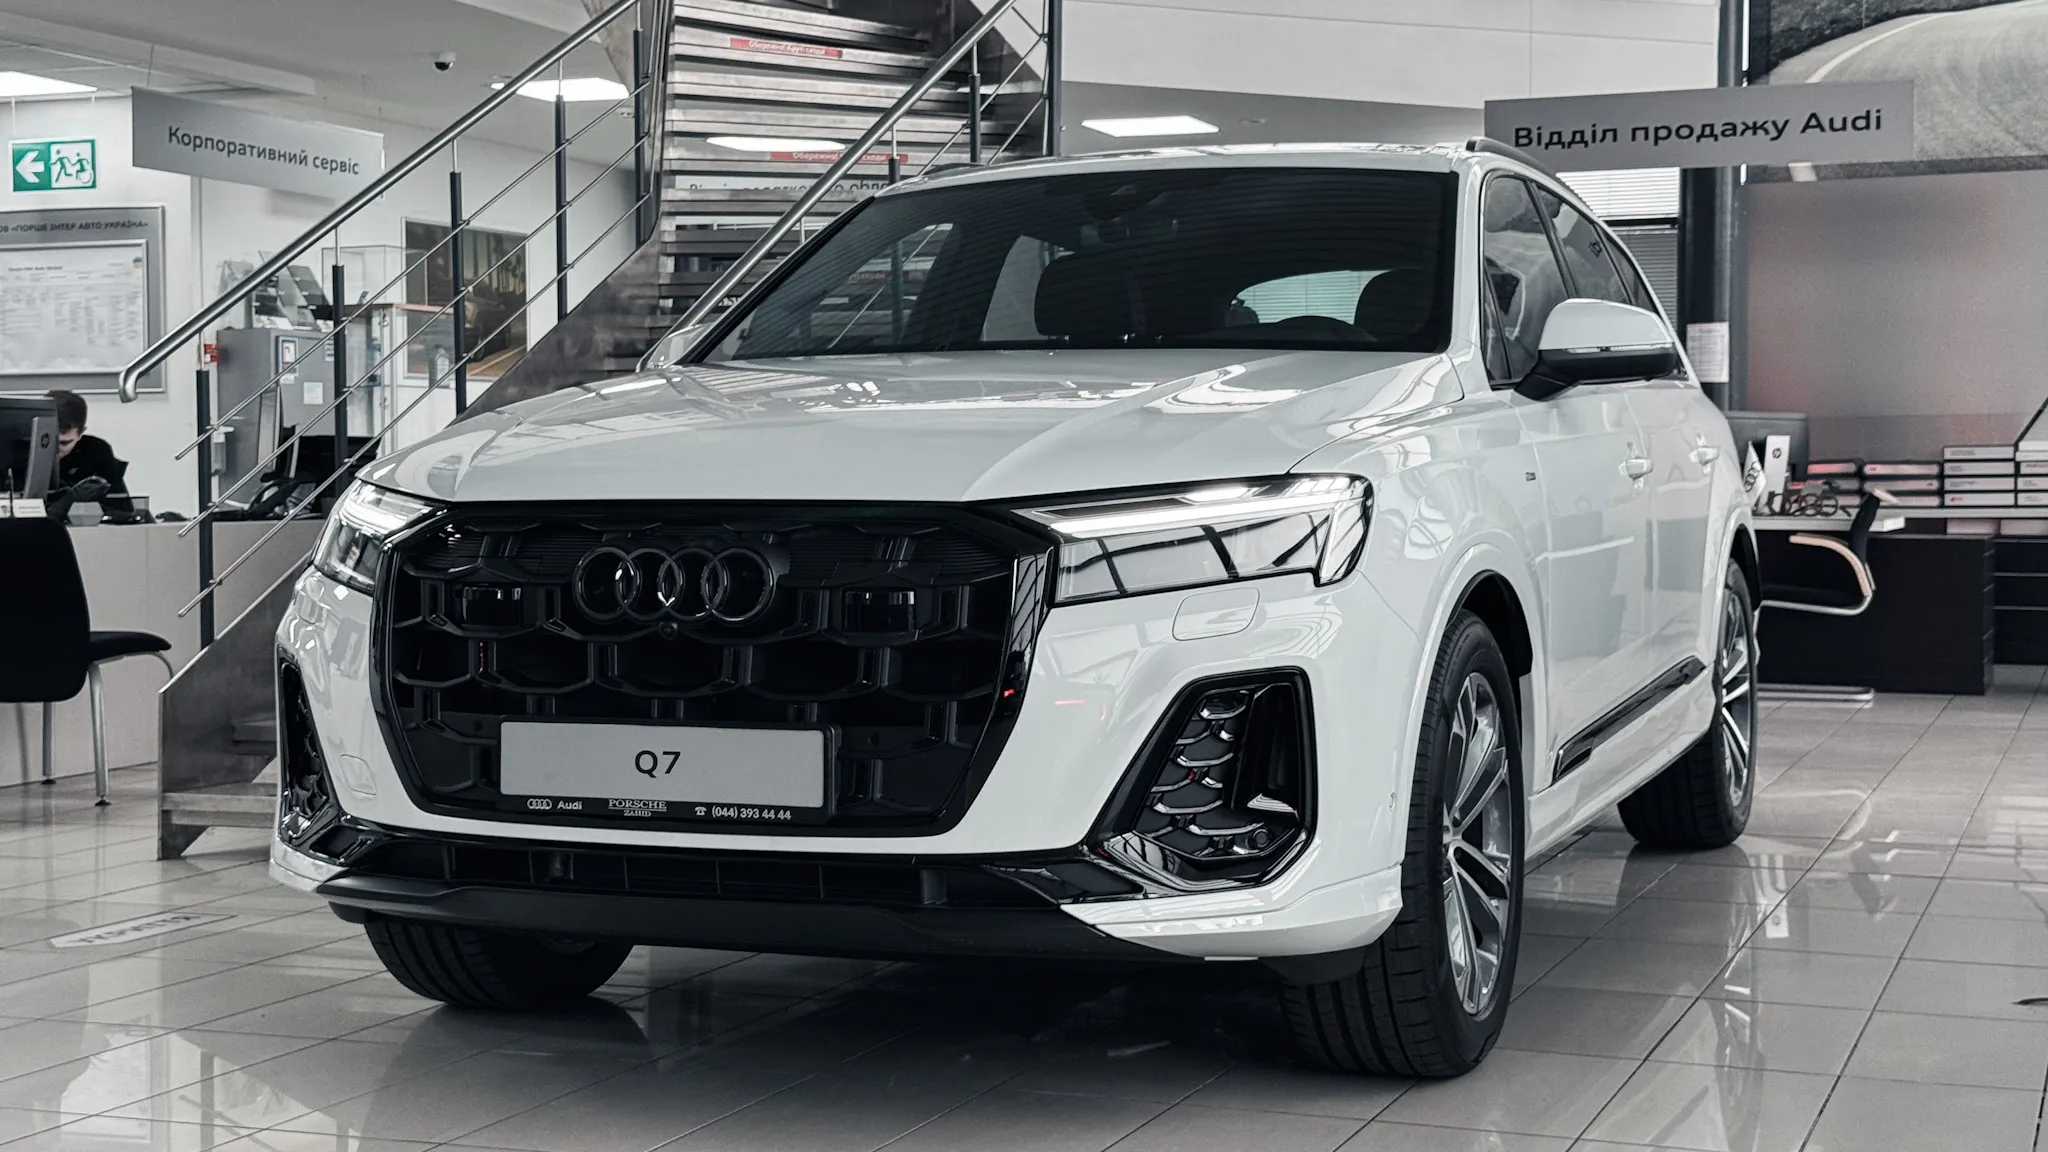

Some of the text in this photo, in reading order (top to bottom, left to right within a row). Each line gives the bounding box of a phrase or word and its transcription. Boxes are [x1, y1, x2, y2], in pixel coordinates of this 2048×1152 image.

[1513, 108, 1882, 150] Відділ продажу Audi
[168, 125, 360, 176] Корпоративний сервіс
[634, 750, 682, 779] Q7
[557, 800, 583, 811] Audi
[608, 798, 668, 809] PORSCHE
[712, 805, 792, 821] (044) 393 44 44
